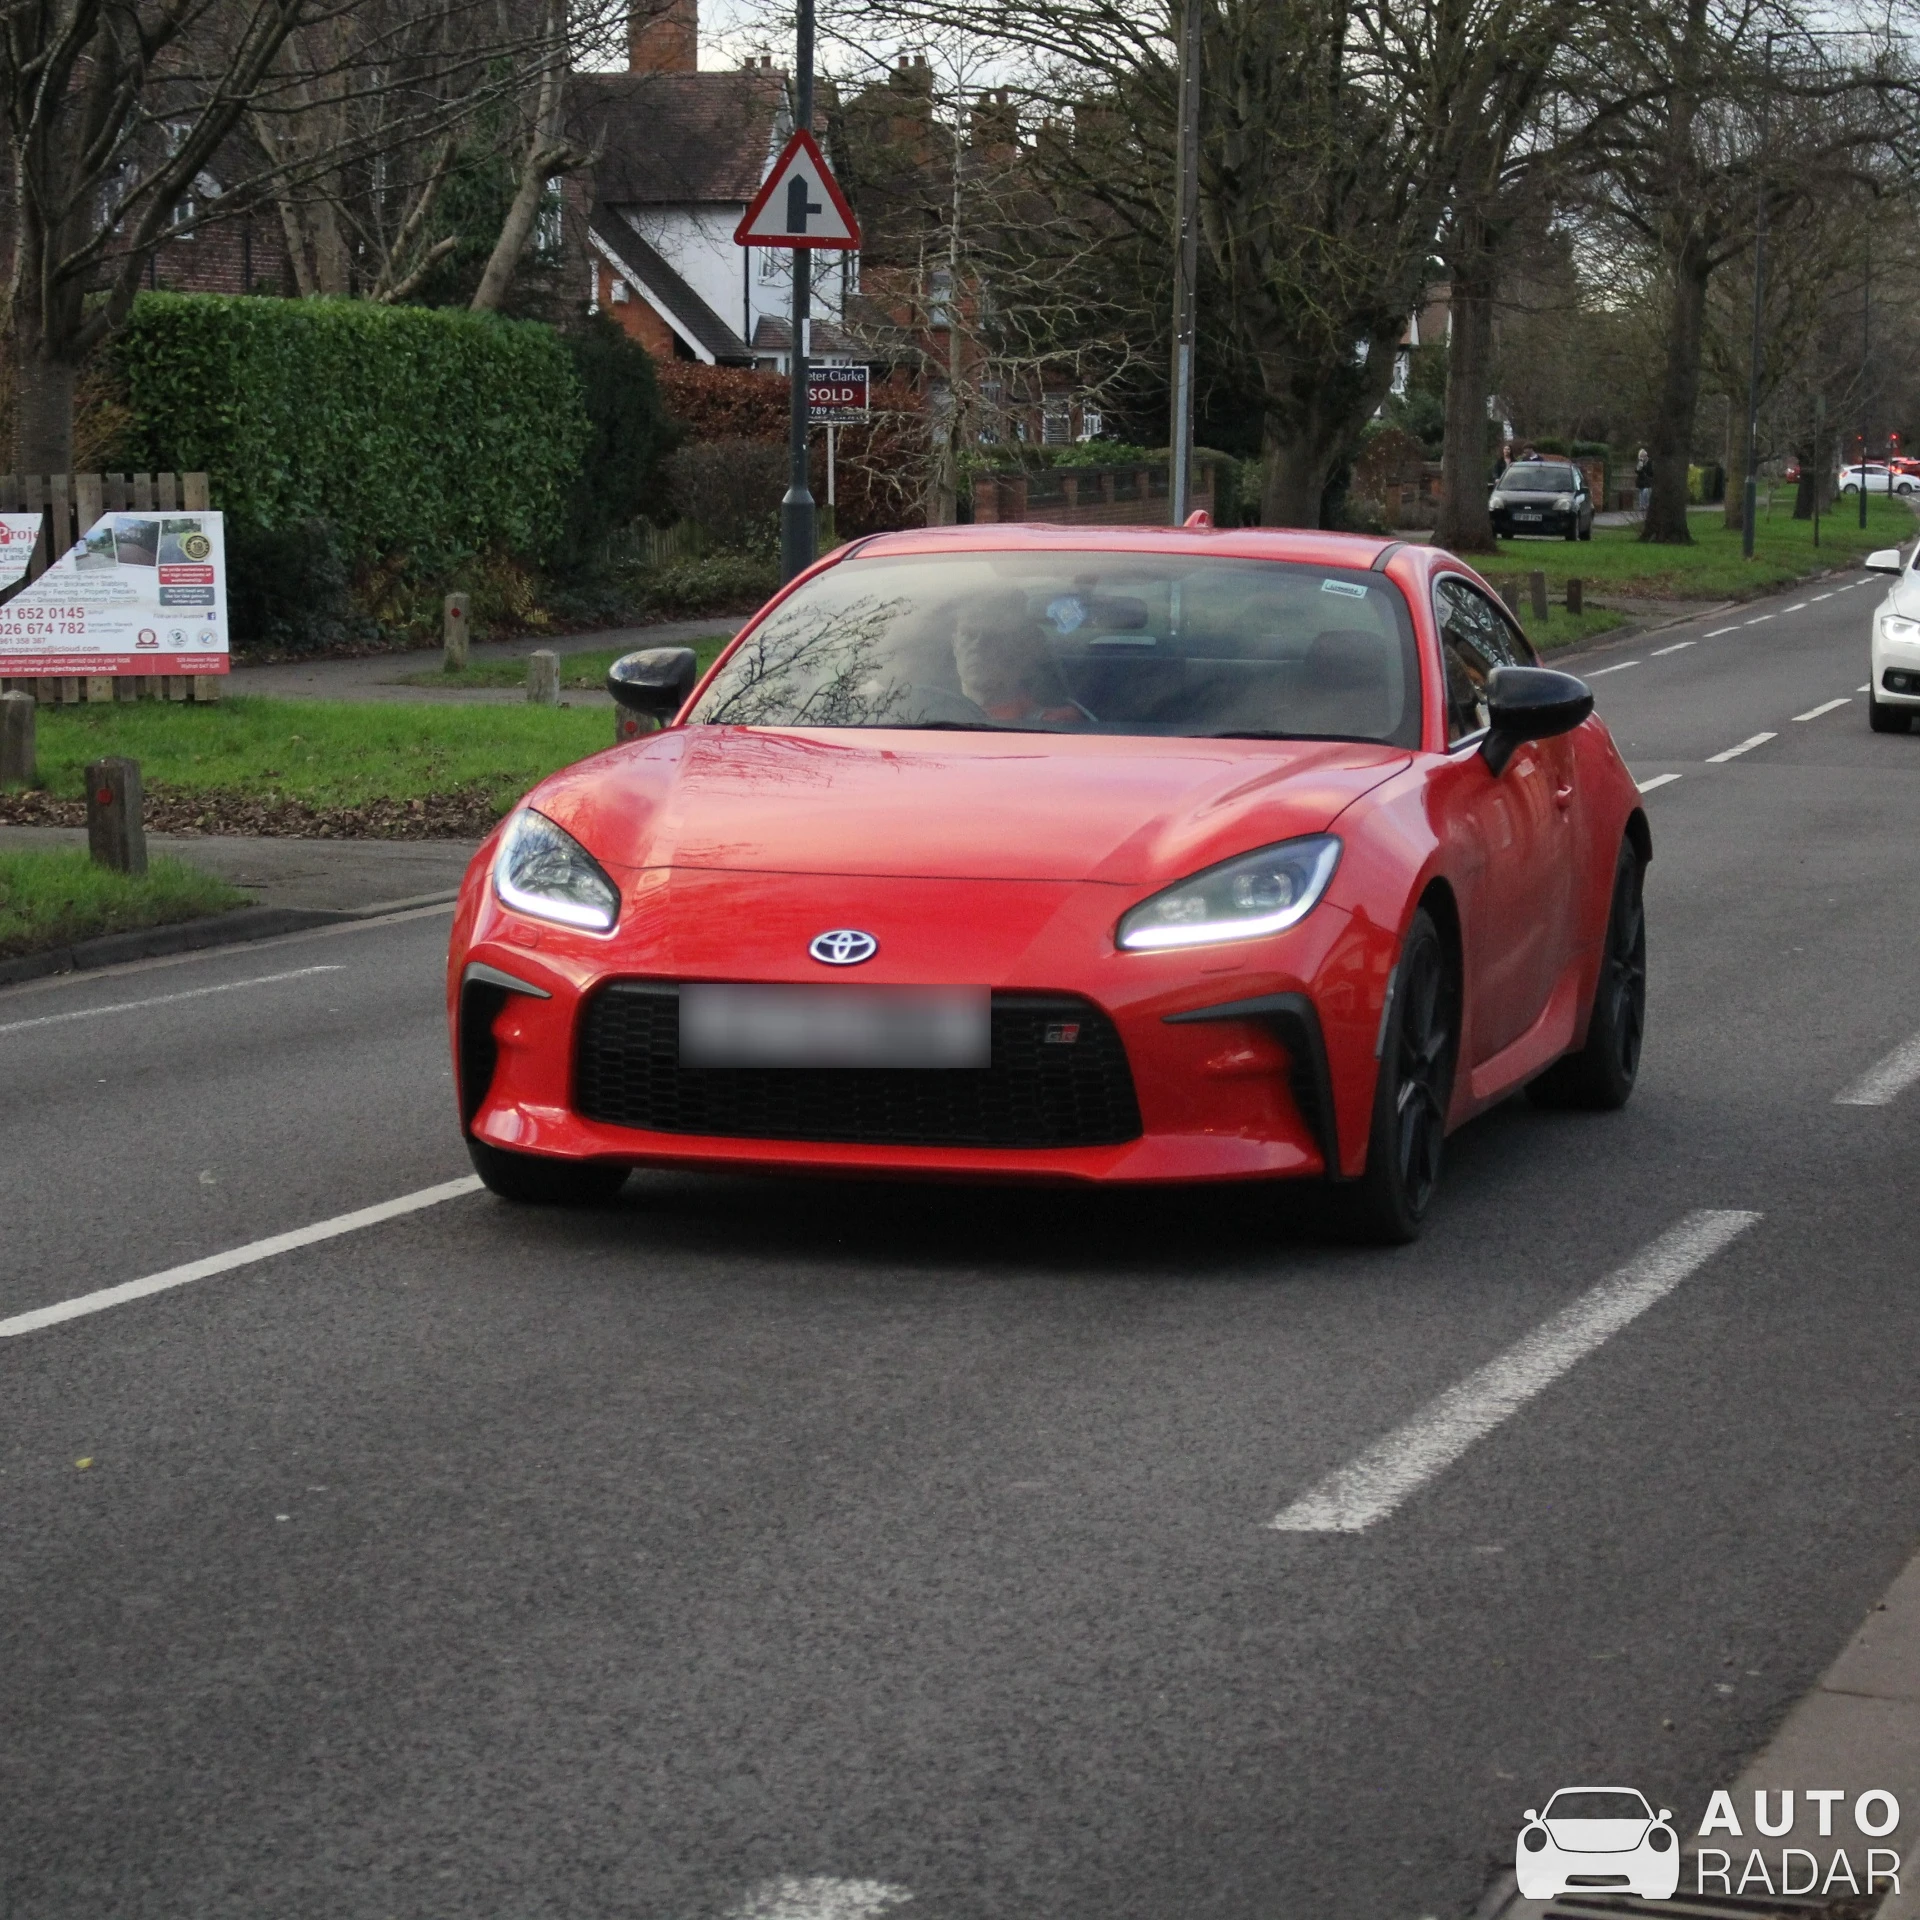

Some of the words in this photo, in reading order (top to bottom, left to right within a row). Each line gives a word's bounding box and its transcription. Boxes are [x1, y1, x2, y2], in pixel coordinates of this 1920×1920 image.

[829, 370, 864, 382] Clarke
[809, 388, 854, 401] SOLD
[810, 407, 827, 415] 789
[17, 607, 44, 620] 652
[49, 607, 85, 619] 0145
[27, 622, 53, 635] 674
[58, 622, 85, 634] 782
